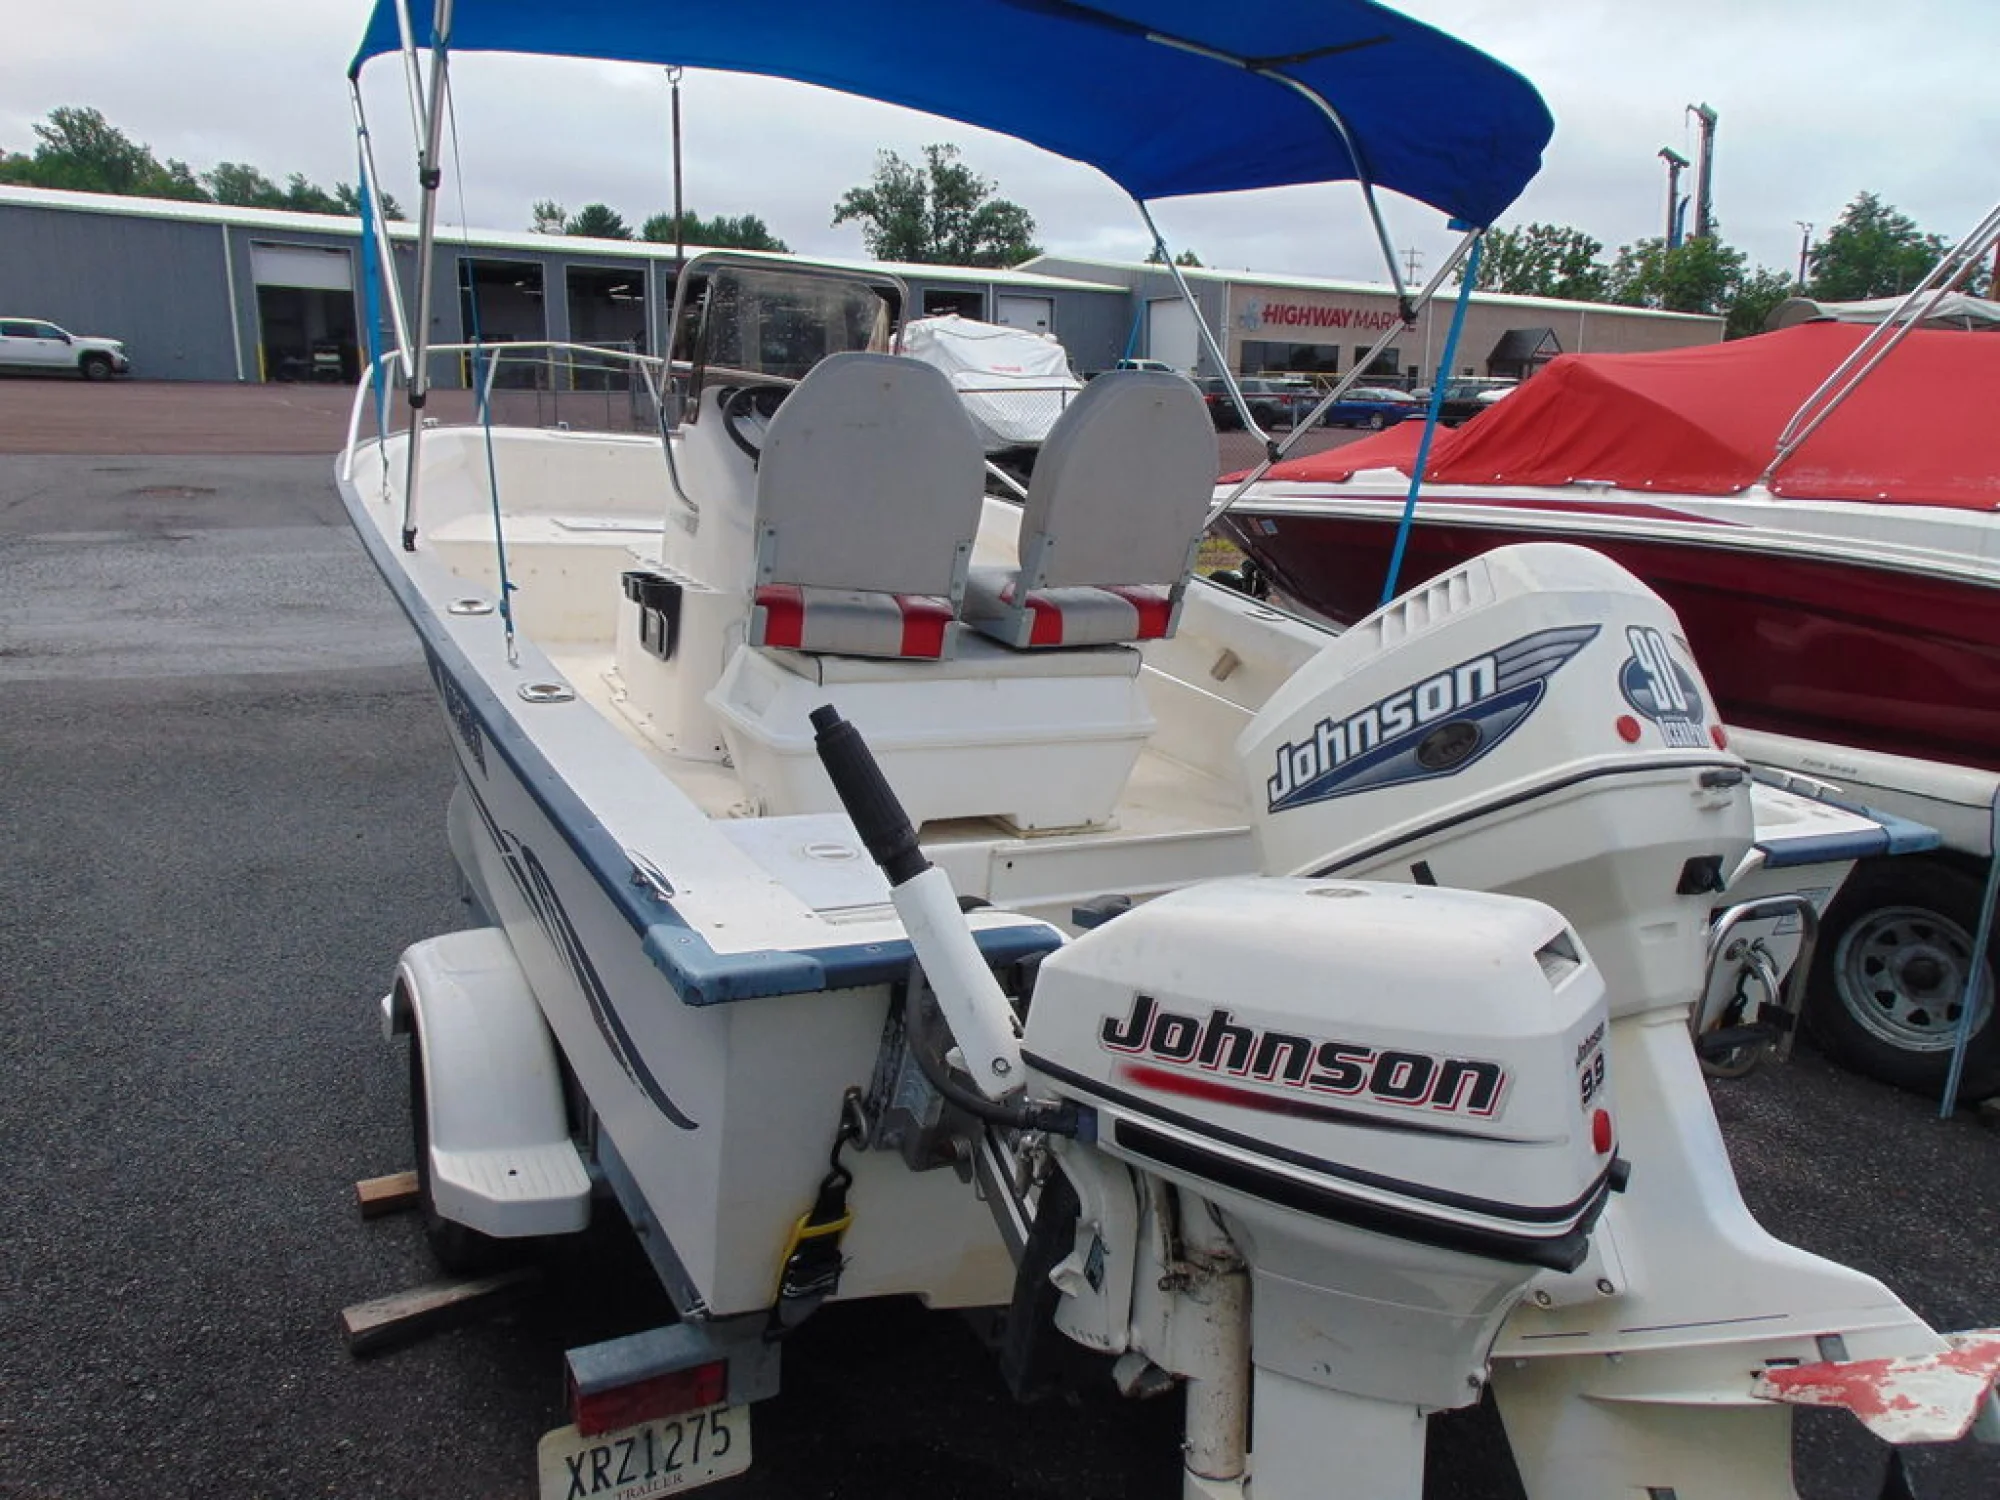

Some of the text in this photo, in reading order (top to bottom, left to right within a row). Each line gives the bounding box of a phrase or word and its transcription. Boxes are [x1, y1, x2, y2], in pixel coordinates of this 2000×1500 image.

[1262, 303, 1416, 333] HIGHWAY MARI
[1625, 625, 1688, 712] 90
[1268, 653, 1499, 804] Johnson
[1102, 995, 1504, 1115] Johnson
[565, 1405, 731, 1500] XRZ1275
[615, 1473, 684, 1500] TRAILER
